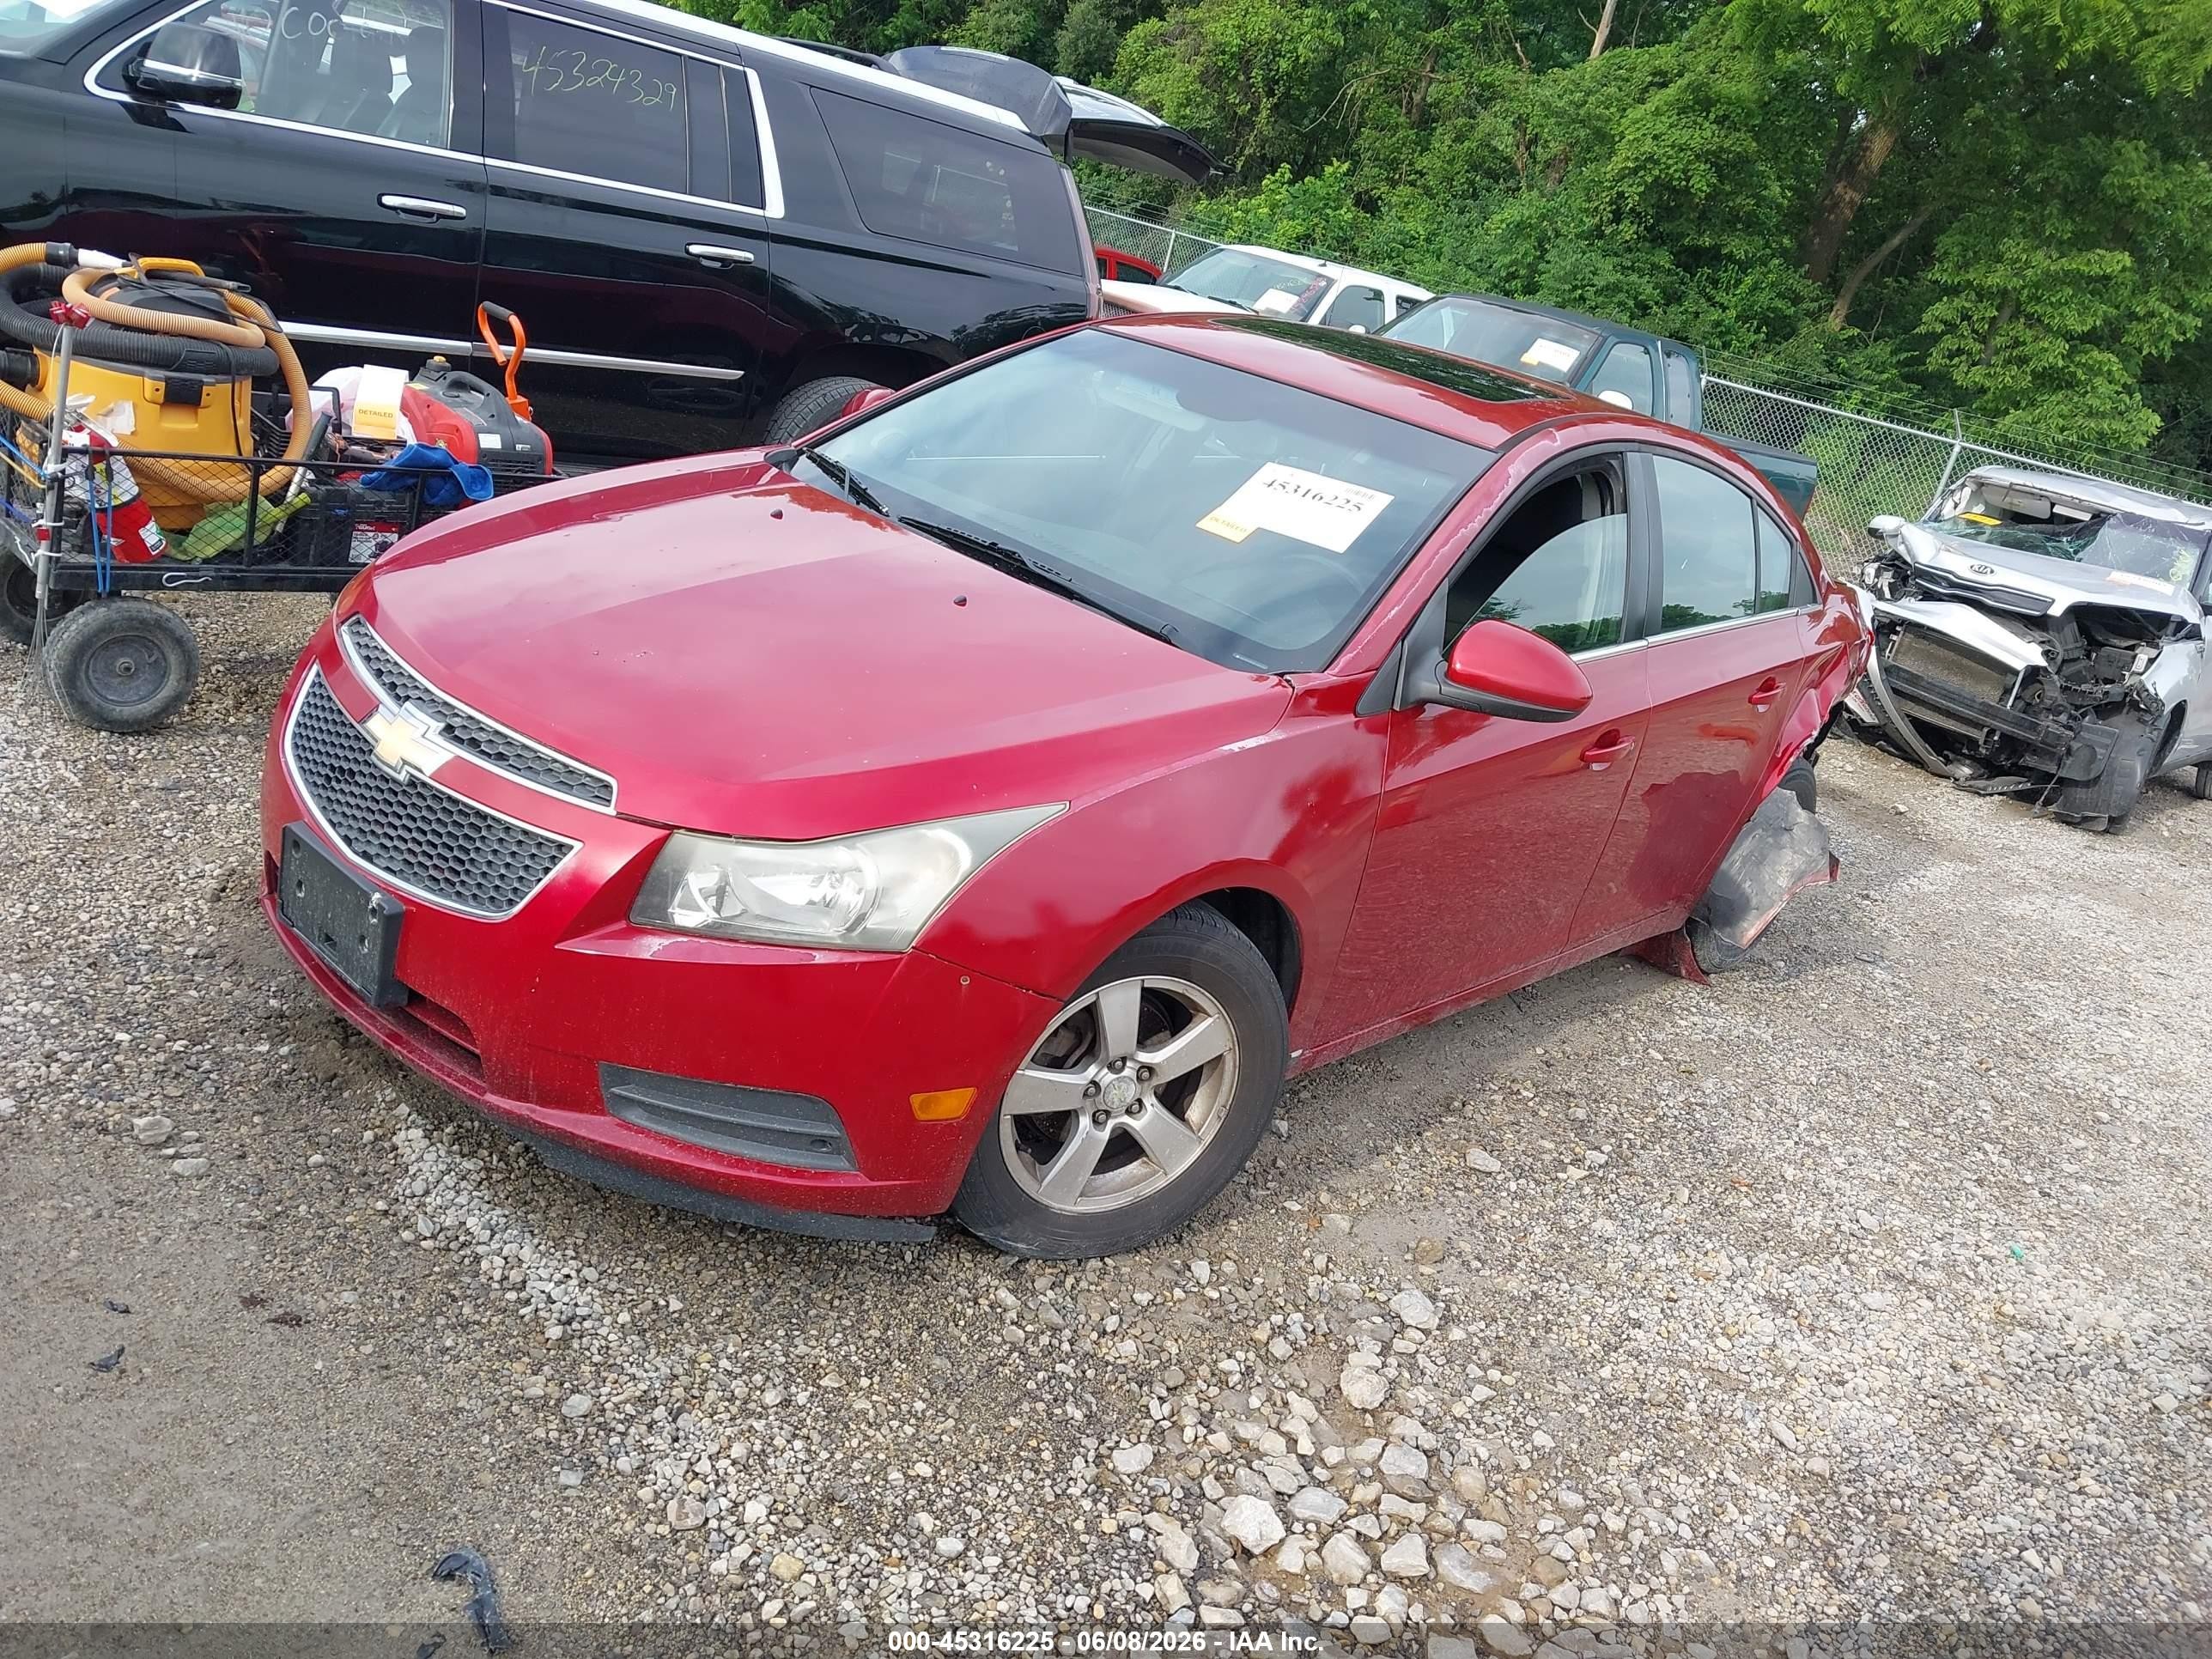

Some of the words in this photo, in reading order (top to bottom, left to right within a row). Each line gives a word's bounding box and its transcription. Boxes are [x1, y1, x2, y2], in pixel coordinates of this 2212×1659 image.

[521, 46, 678, 112] 45324329
[358, 409, 393, 418] DETAILED
[1261, 478, 1365, 512] 45316225
[1971, 564, 1992, 574] KIA
